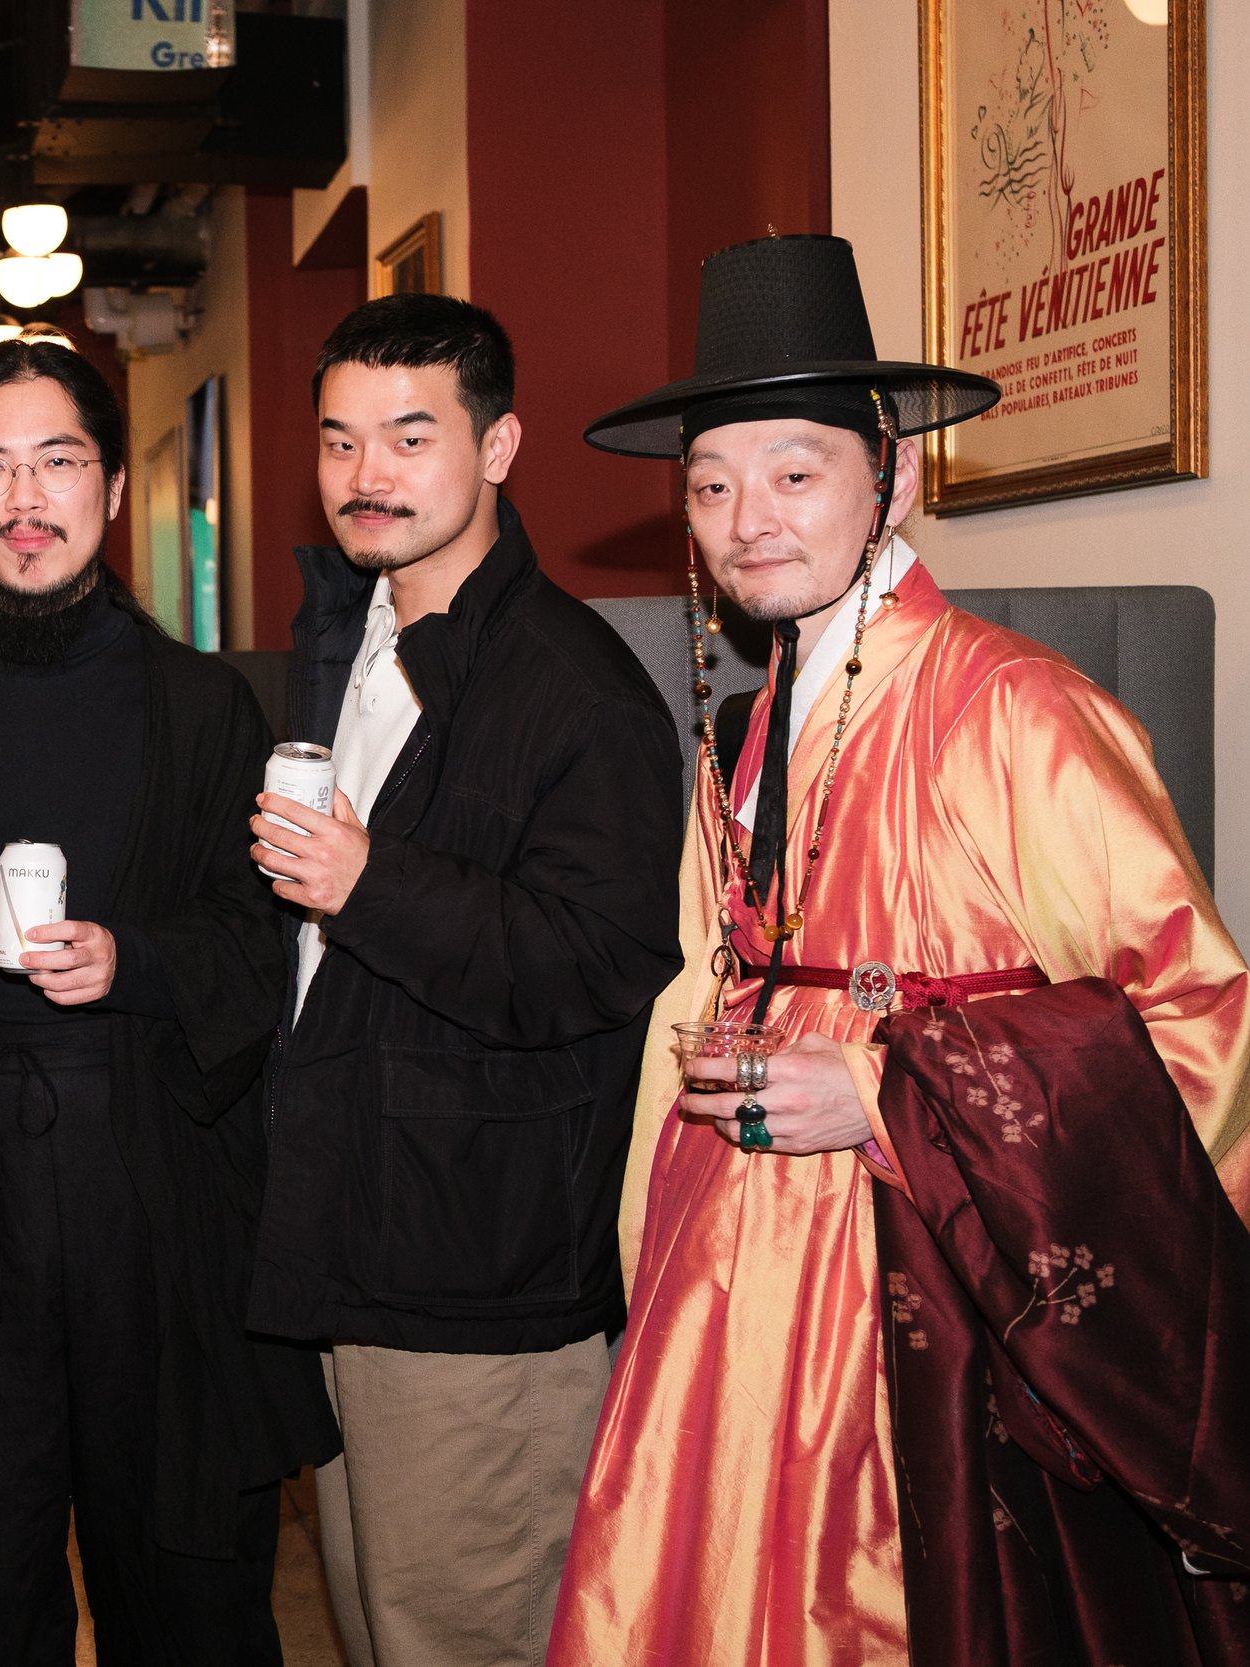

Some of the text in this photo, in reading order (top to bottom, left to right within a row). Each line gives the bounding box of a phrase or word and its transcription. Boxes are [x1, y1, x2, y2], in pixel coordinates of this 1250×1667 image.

[1066, 168, 1165, 260] GRANDE
[959, 236, 1165, 360] FÊTE VÉNITIENNE
[1016, 379, 1026, 393] DE
[1100, 356, 1112, 372] DE
[1115, 349, 1138, 368] NUIT
[1026, 356, 1040, 371] FEU
[1044, 342, 1088, 367] D'ARTIFICE,
[1092, 328, 1137, 353] CONCERTS
[9, 868, 50, 878] MAKKU
